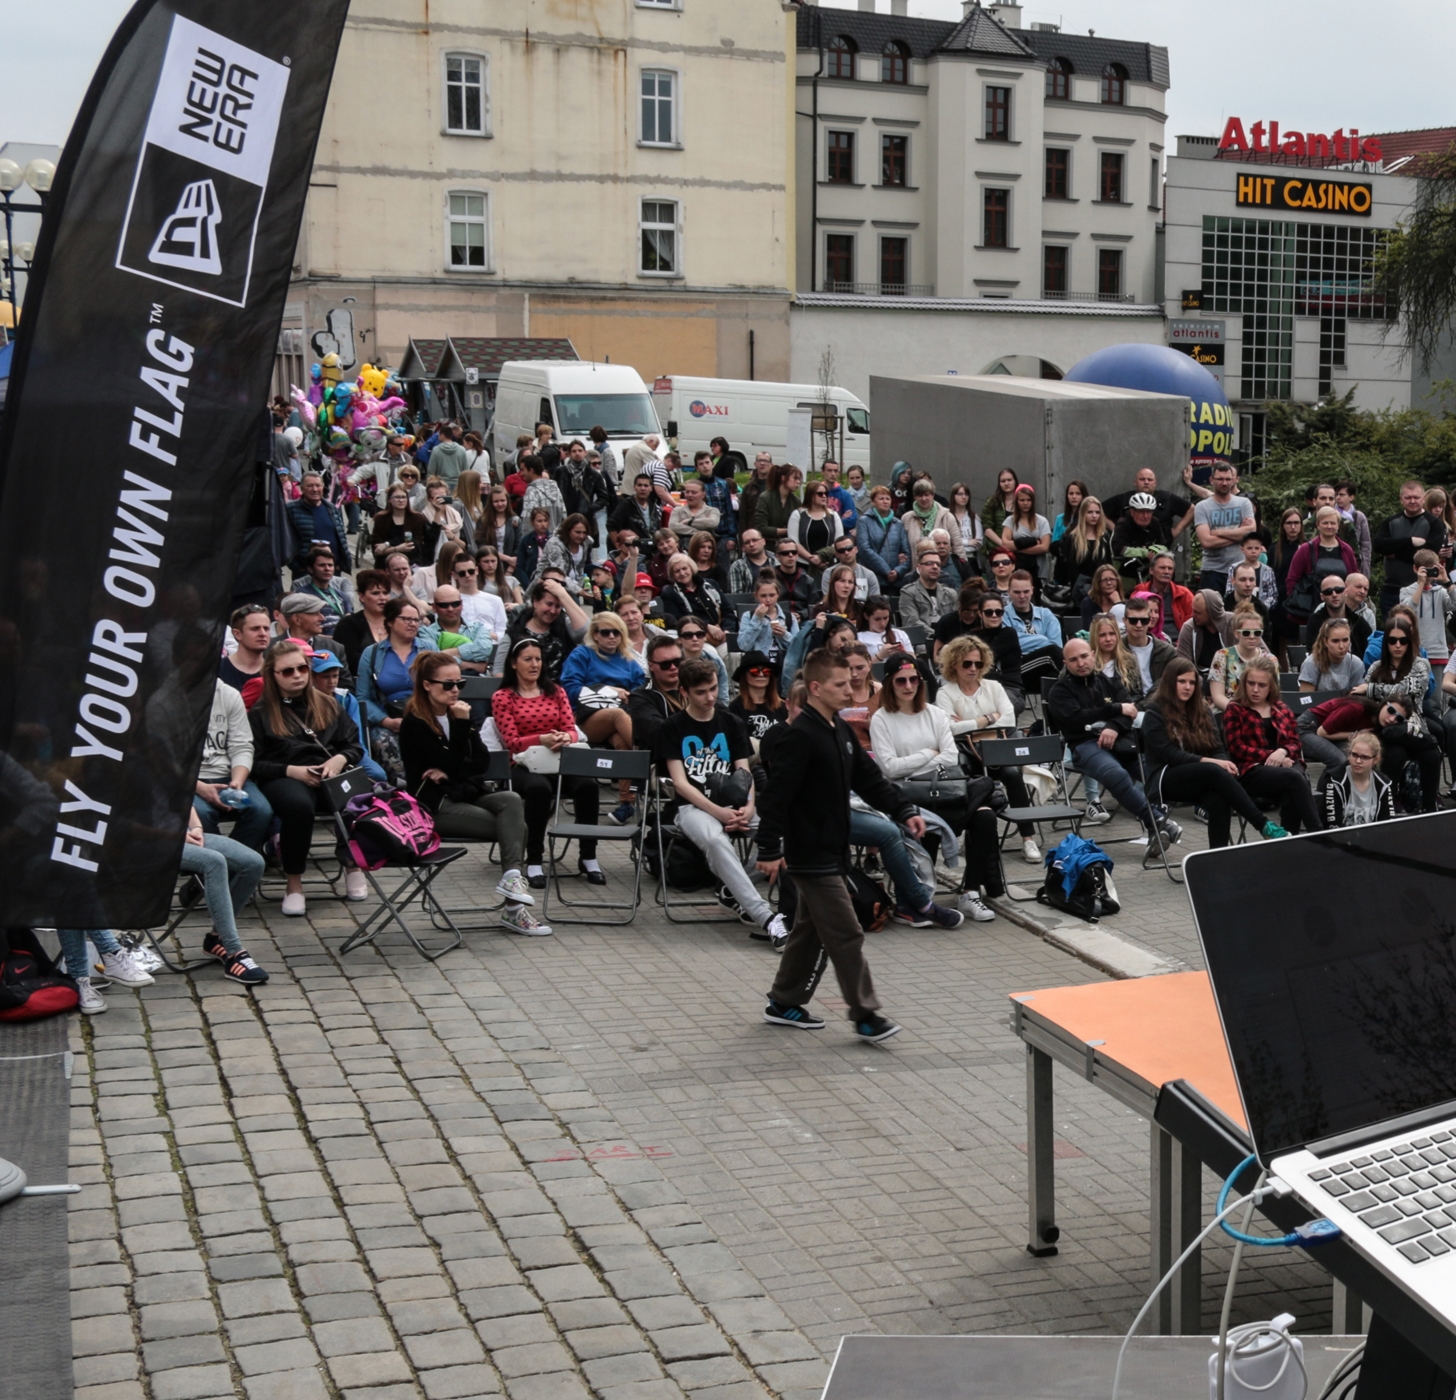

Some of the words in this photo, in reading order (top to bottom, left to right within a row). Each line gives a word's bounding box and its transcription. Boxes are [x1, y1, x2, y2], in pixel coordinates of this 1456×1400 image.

[179, 47, 226, 143] NEW
[212, 63, 259, 155] ERA
[1217, 116, 1383, 162] Atlantis
[1238, 176, 1276, 205] HIT
[1283, 180, 1371, 213] CASINO
[1173, 322, 1220, 330] solarium
[1173, 329, 1220, 338] atlantis
[691, 403, 729, 416] MAXI
[1191, 401, 1234, 428] RADI
[104, 470, 173, 608] OWN
[71, 618, 148, 762] YOUR
[1326, 783, 1336, 822] BLAZING
[50, 778, 112, 873] FLY
